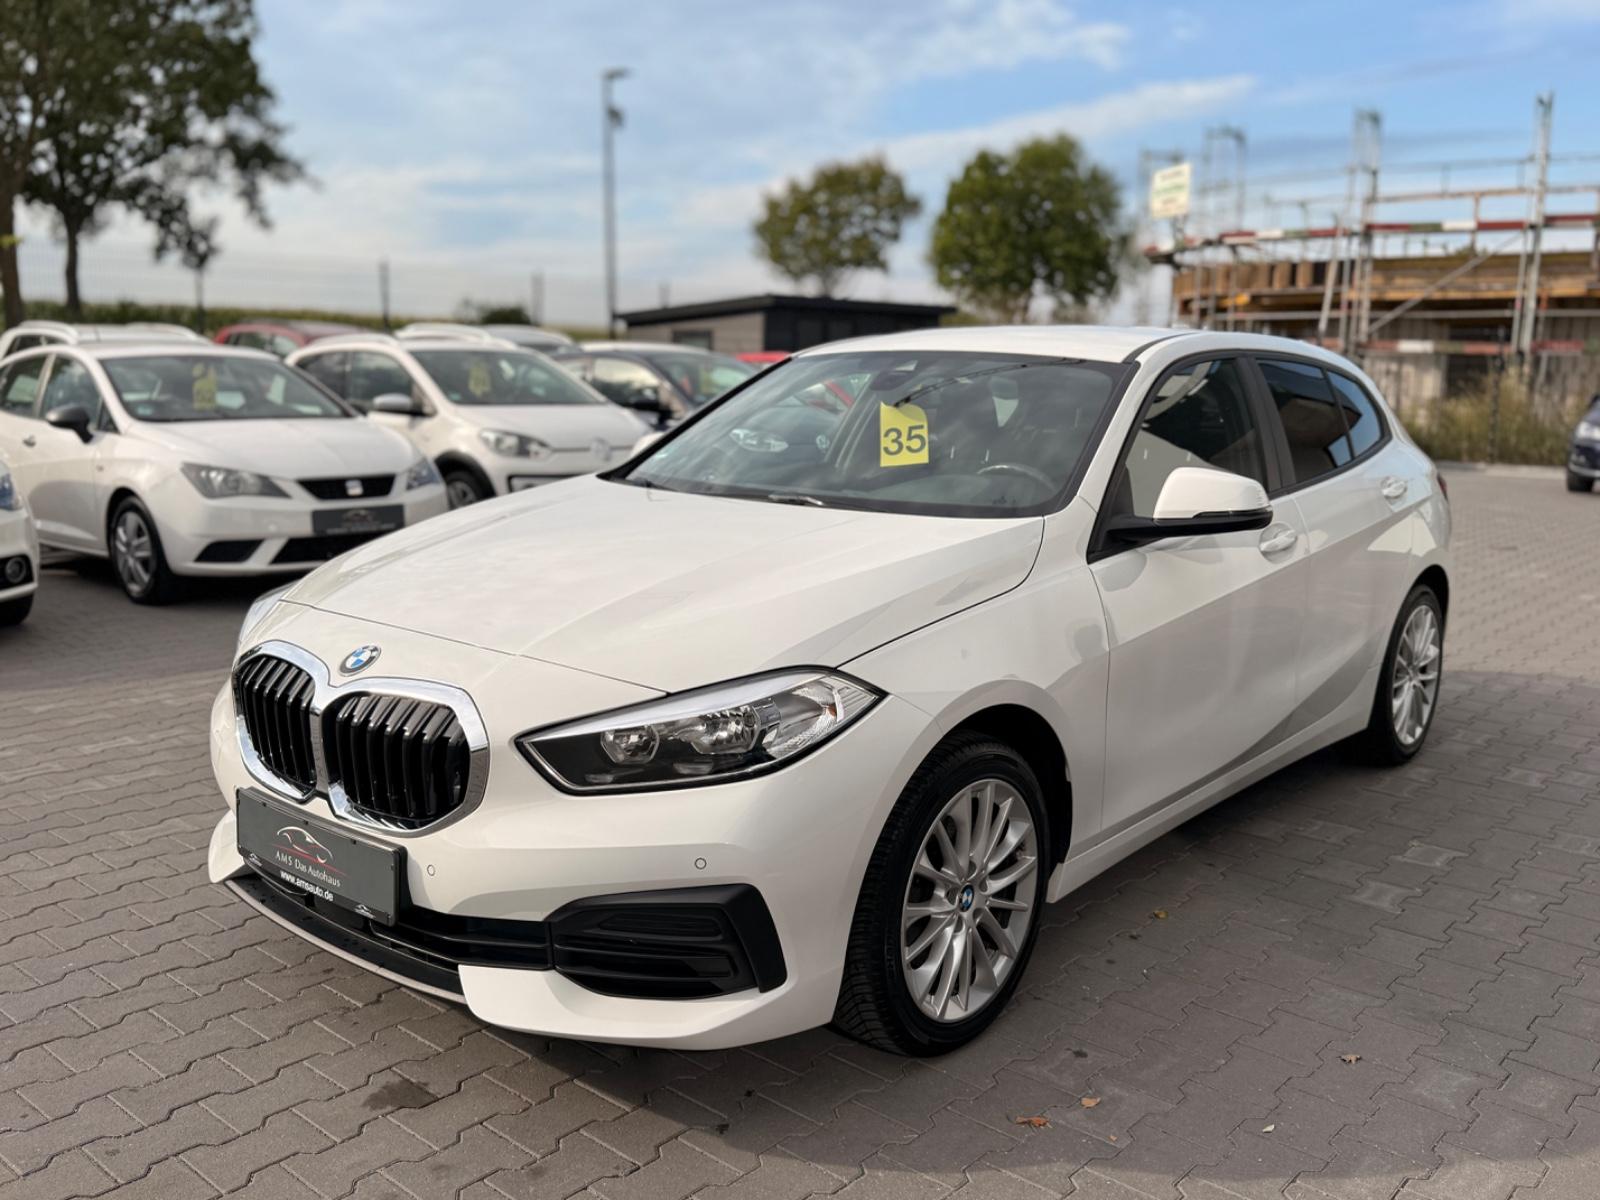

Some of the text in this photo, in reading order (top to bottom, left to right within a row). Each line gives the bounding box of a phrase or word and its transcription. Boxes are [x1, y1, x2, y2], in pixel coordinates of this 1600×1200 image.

[883, 425, 926, 456] 35
[275, 850, 293, 866] AMS
[295, 858, 307, 873] Das
[308, 865, 341, 887] Autohaus
[280, 870, 334, 902] www.amsauto.de
